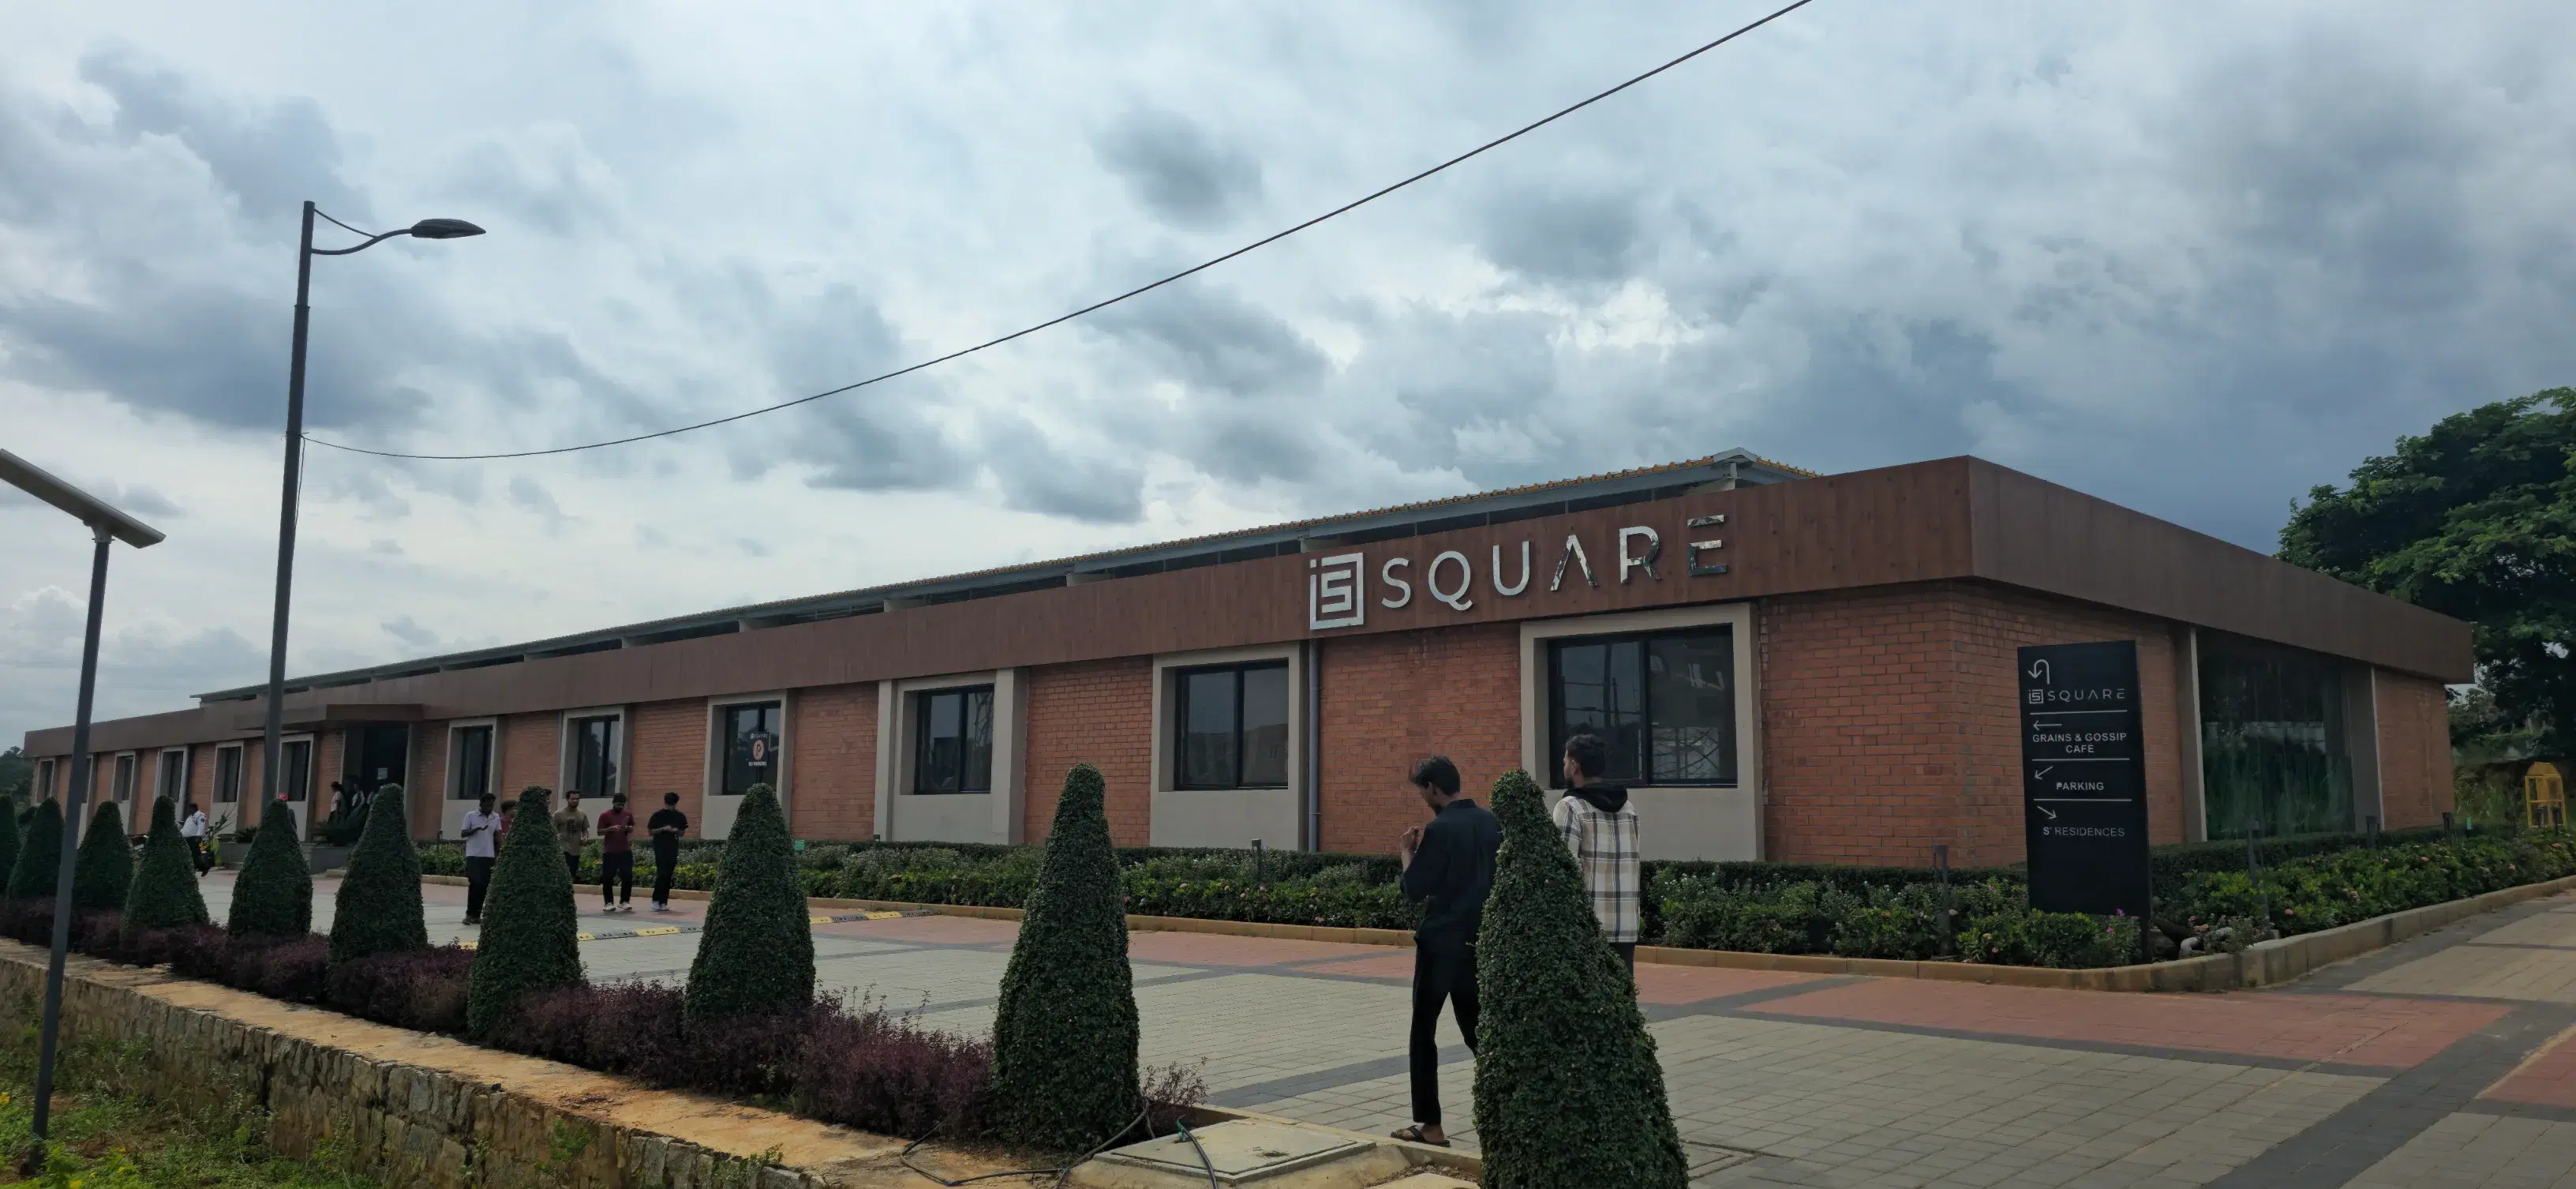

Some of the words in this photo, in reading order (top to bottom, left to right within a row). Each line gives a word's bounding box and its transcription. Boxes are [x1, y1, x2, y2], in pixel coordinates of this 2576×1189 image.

[1382, 515, 1728, 610] SQUARE
[2047, 688, 2125, 702] SQUARE
[2032, 733, 2072, 743] GRAINS
[2074, 733, 2082, 742] &
[2084, 733, 2127, 742] GOSSIP
[2065, 743, 2095, 753] CAFÉ
[2056, 782, 2105, 791] PARKING
[2054, 827, 2125, 837] RESIDENCES
